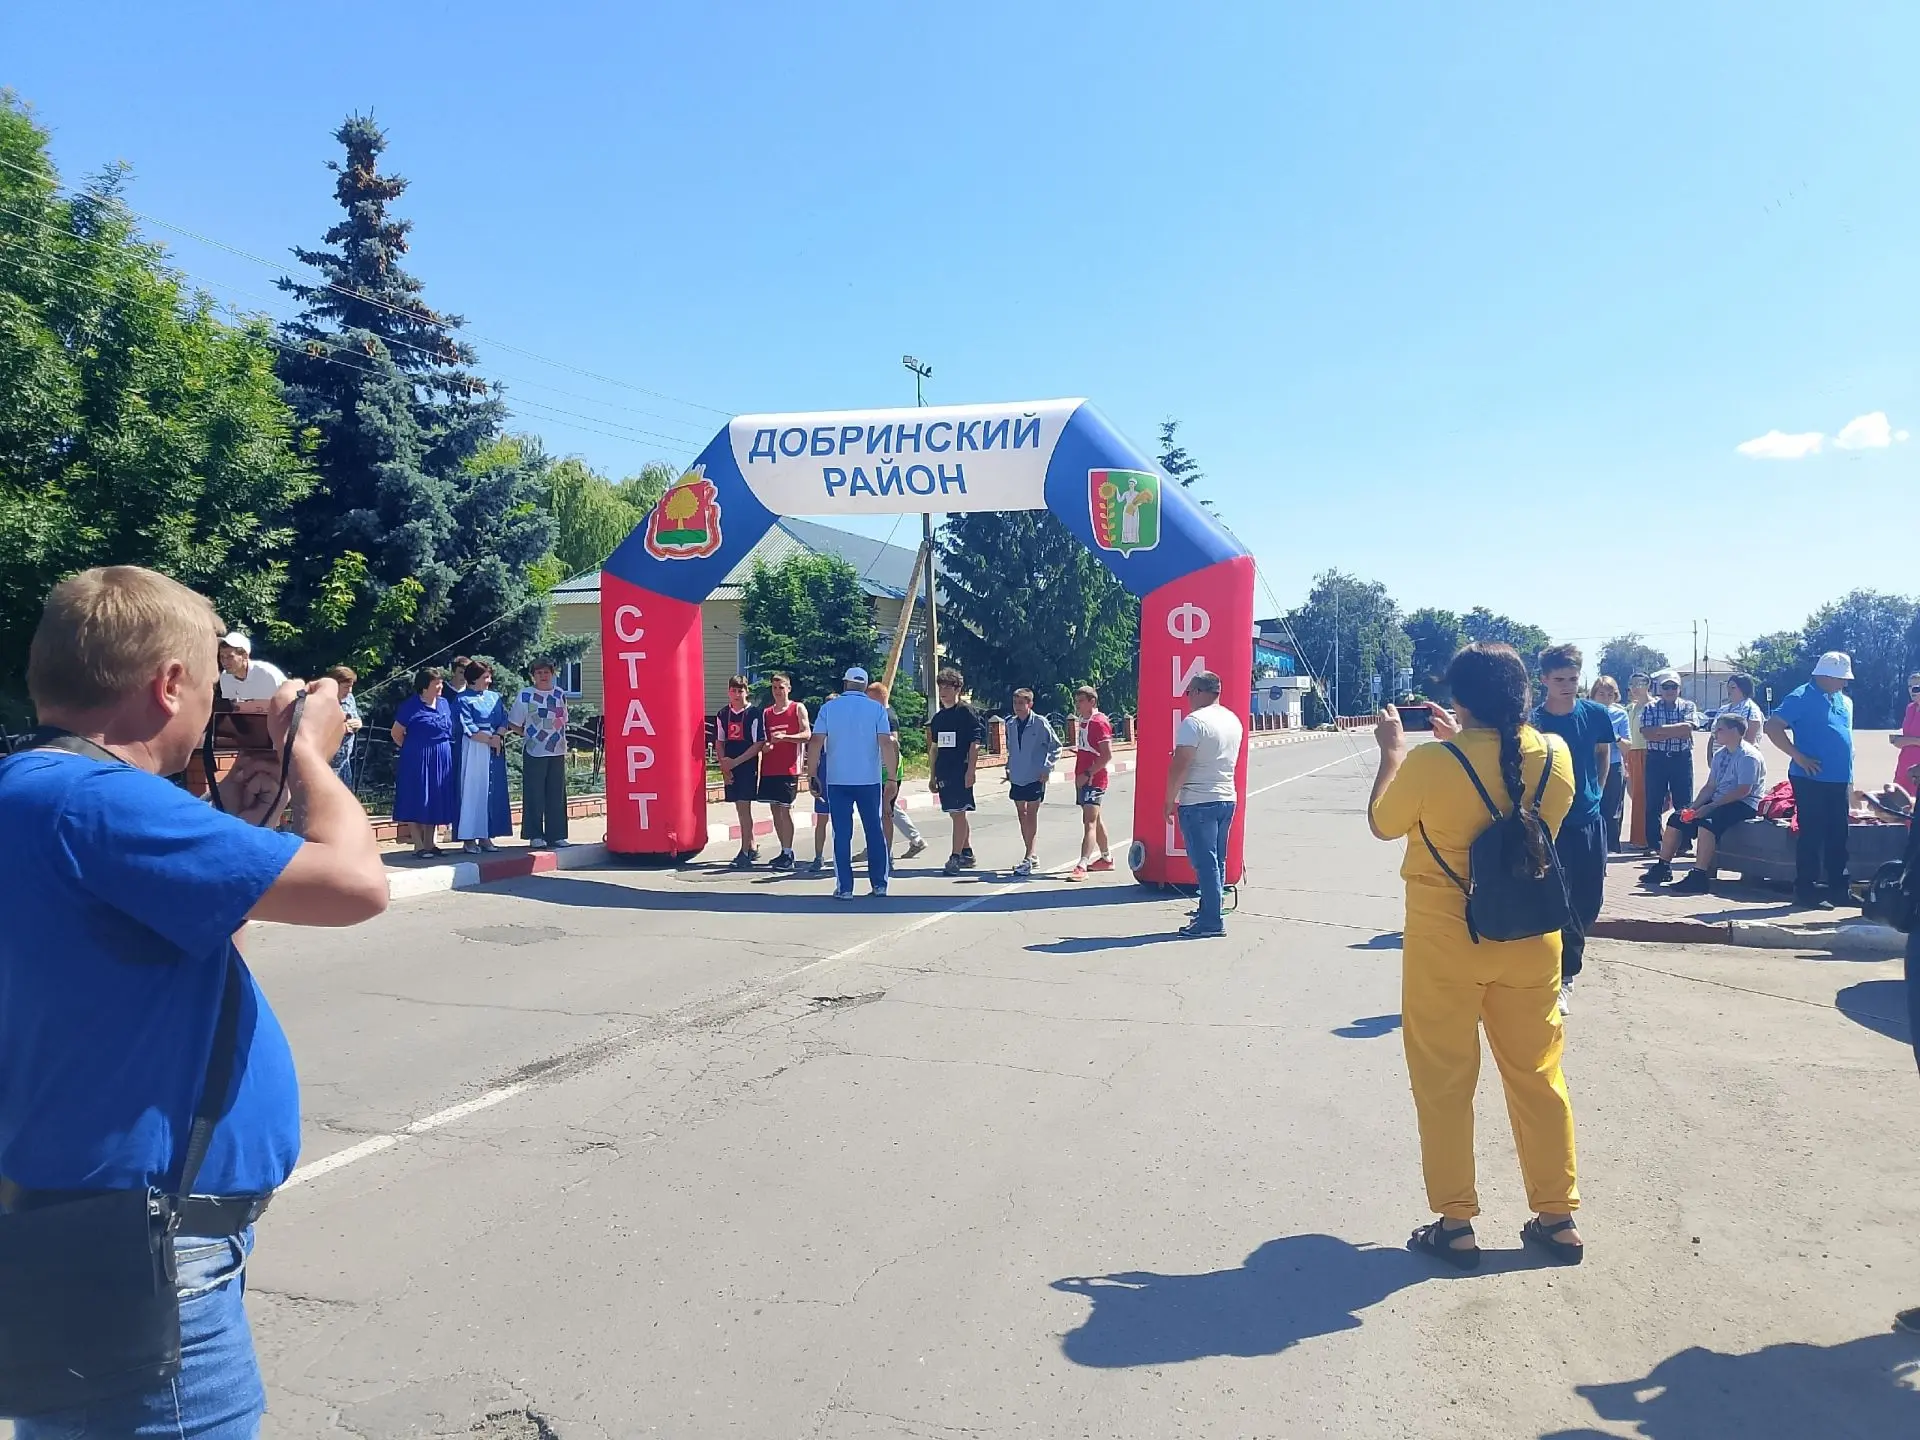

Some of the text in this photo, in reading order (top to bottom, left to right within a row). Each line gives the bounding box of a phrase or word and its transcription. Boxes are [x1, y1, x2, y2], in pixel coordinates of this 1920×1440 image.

[748, 411, 1042, 464] ДОБРИНСКИЙ
[822, 457, 968, 497] РАЙОН
[614, 604, 658, 830] СТАРТ
[730, 724, 741, 738] 2
